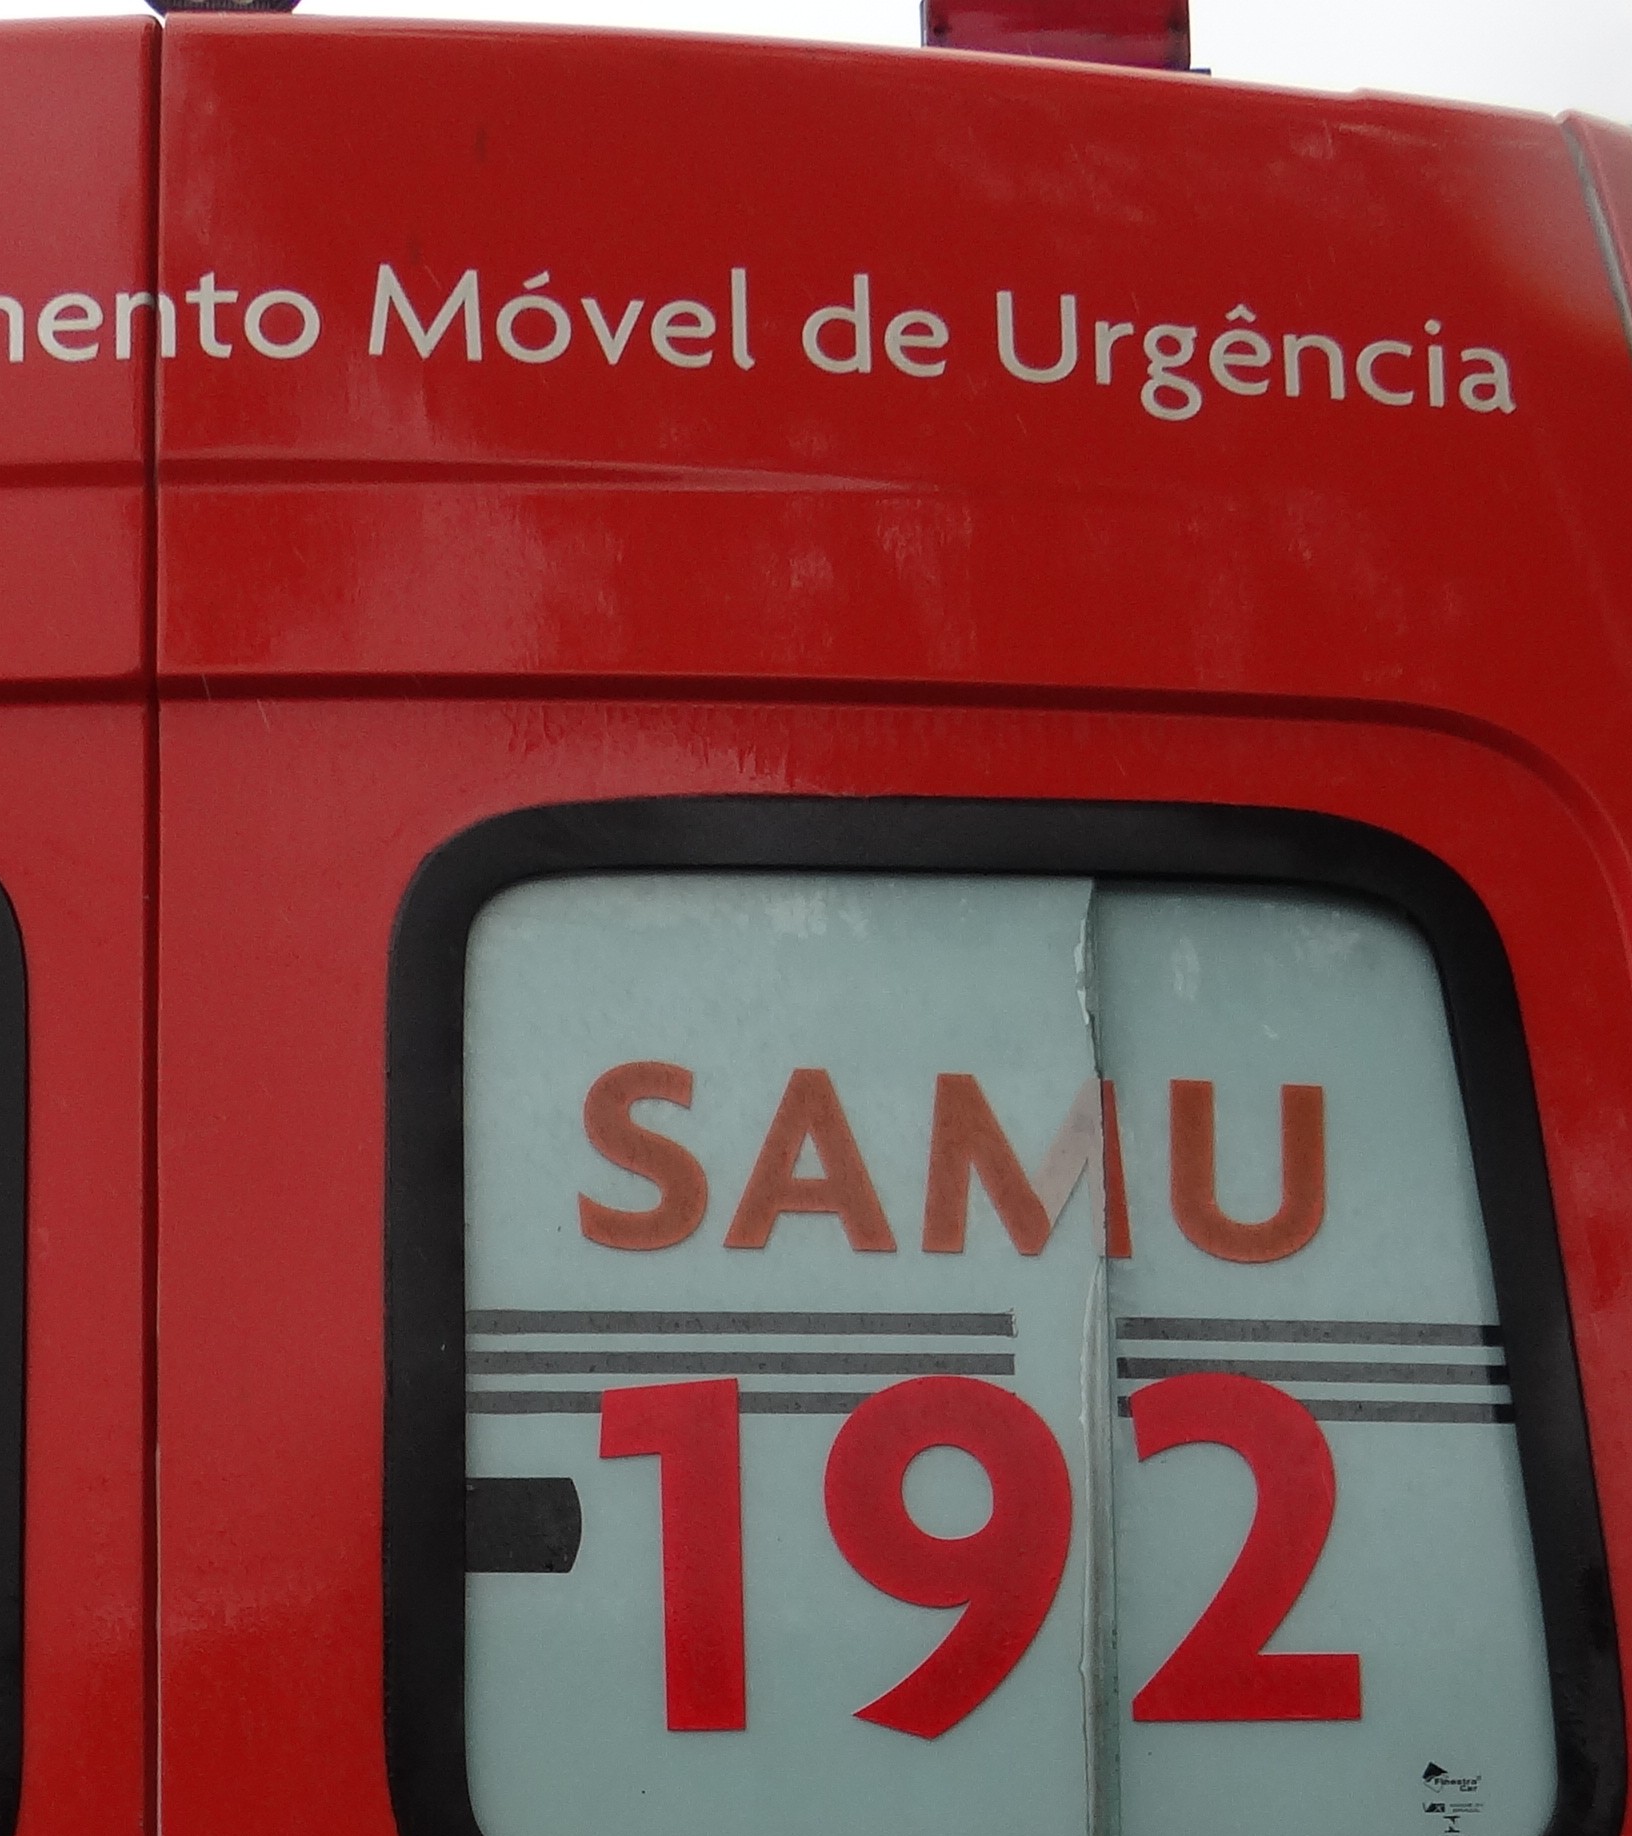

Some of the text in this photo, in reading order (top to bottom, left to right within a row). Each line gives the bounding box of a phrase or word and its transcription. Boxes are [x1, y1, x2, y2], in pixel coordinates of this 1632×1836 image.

[368, 263, 756, 371] Móvel
[801, 273, 950, 378] de
[996, 289, 1517, 421] Urgência
[577, 1060, 1327, 1264] SAMU
[599, 1371, 1362, 1741] 192
